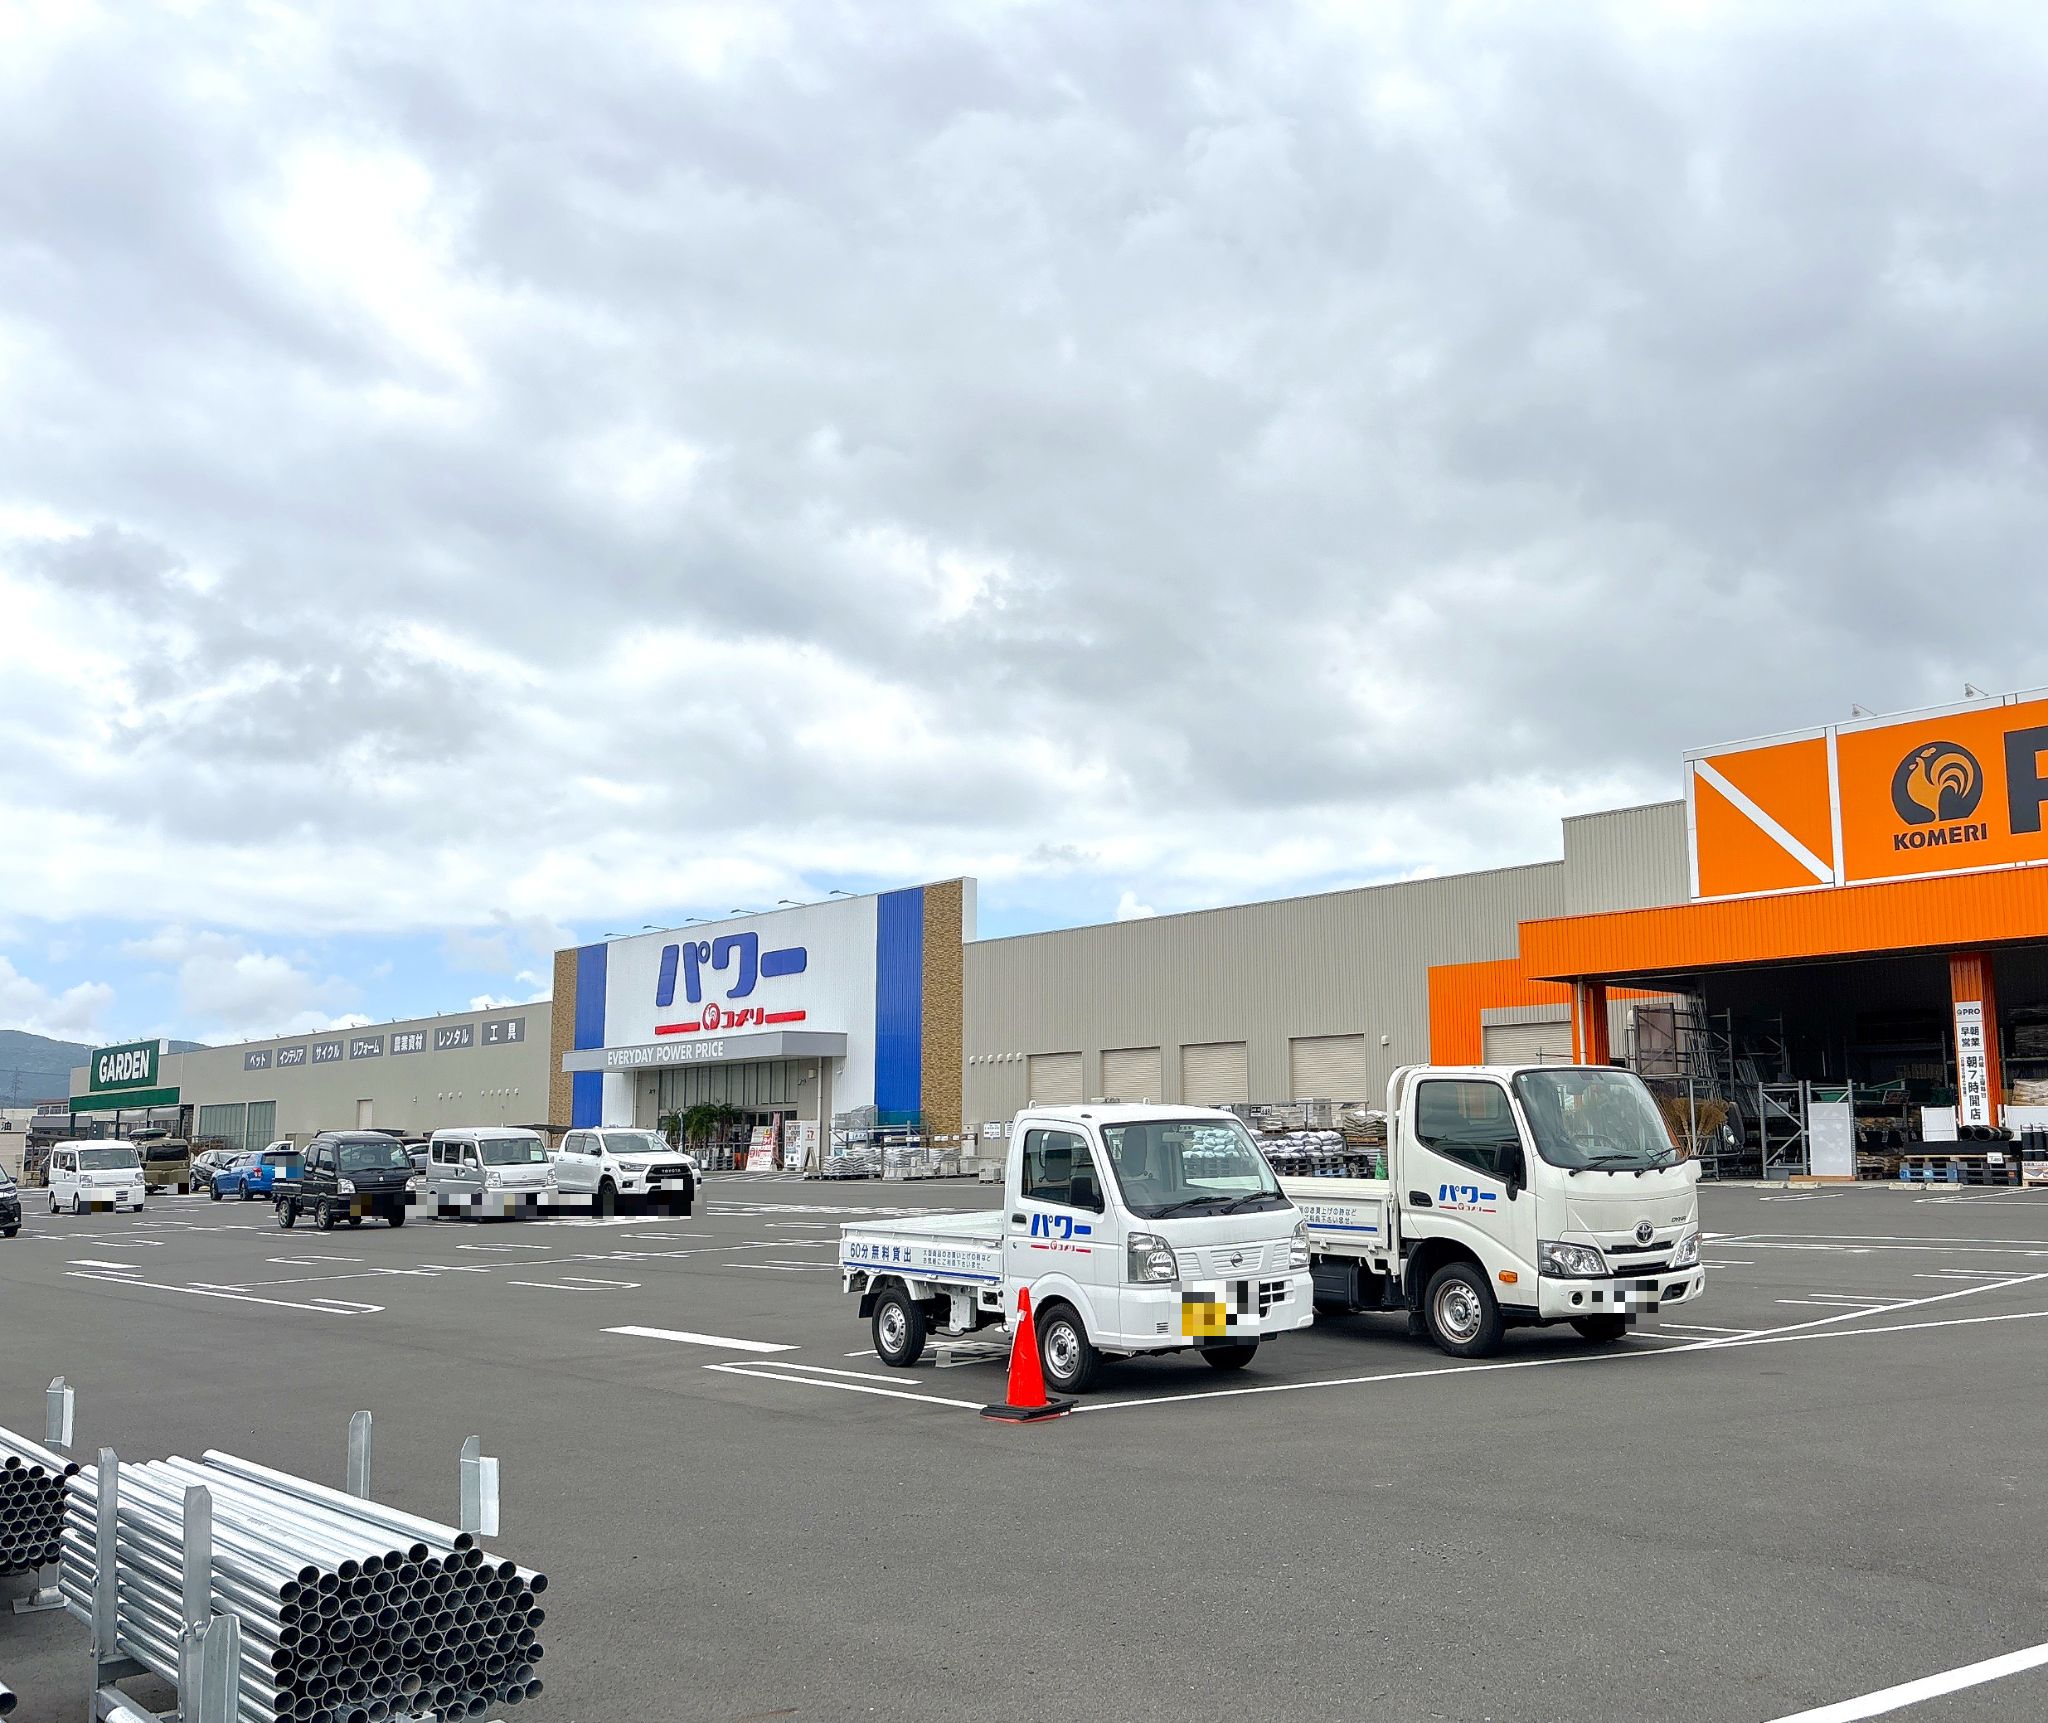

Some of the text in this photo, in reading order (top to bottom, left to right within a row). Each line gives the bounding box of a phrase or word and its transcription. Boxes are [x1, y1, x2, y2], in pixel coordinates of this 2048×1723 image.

[1893, 822, 1988, 851] KOMERI
[655, 931, 808, 1008] パワー
[721, 1007, 765, 1029] コメリ
[1962, 1008, 1981, 1016] PRO
[438, 1028, 470, 1047] レンタル
[489, 1022, 517, 1042] 工具
[1961, 1026, 1980, 1036] 早朝
[352, 1039, 380, 1057] リフォーム
[393, 1033, 424, 1052] 農業資材
[1962, 1037, 1981, 1048] 営業
[249, 1052, 266, 1067] ペット
[279, 1048, 304, 1065] インテリア
[315, 1044, 340, 1061] サイクル
[607, 1041, 724, 1066] EVERYDAY POWER PRICE
[98, 1049, 151, 1084] GARDEN
[1438, 1184, 1497, 1204] パワー
[1030, 1213, 1092, 1239] パワー
